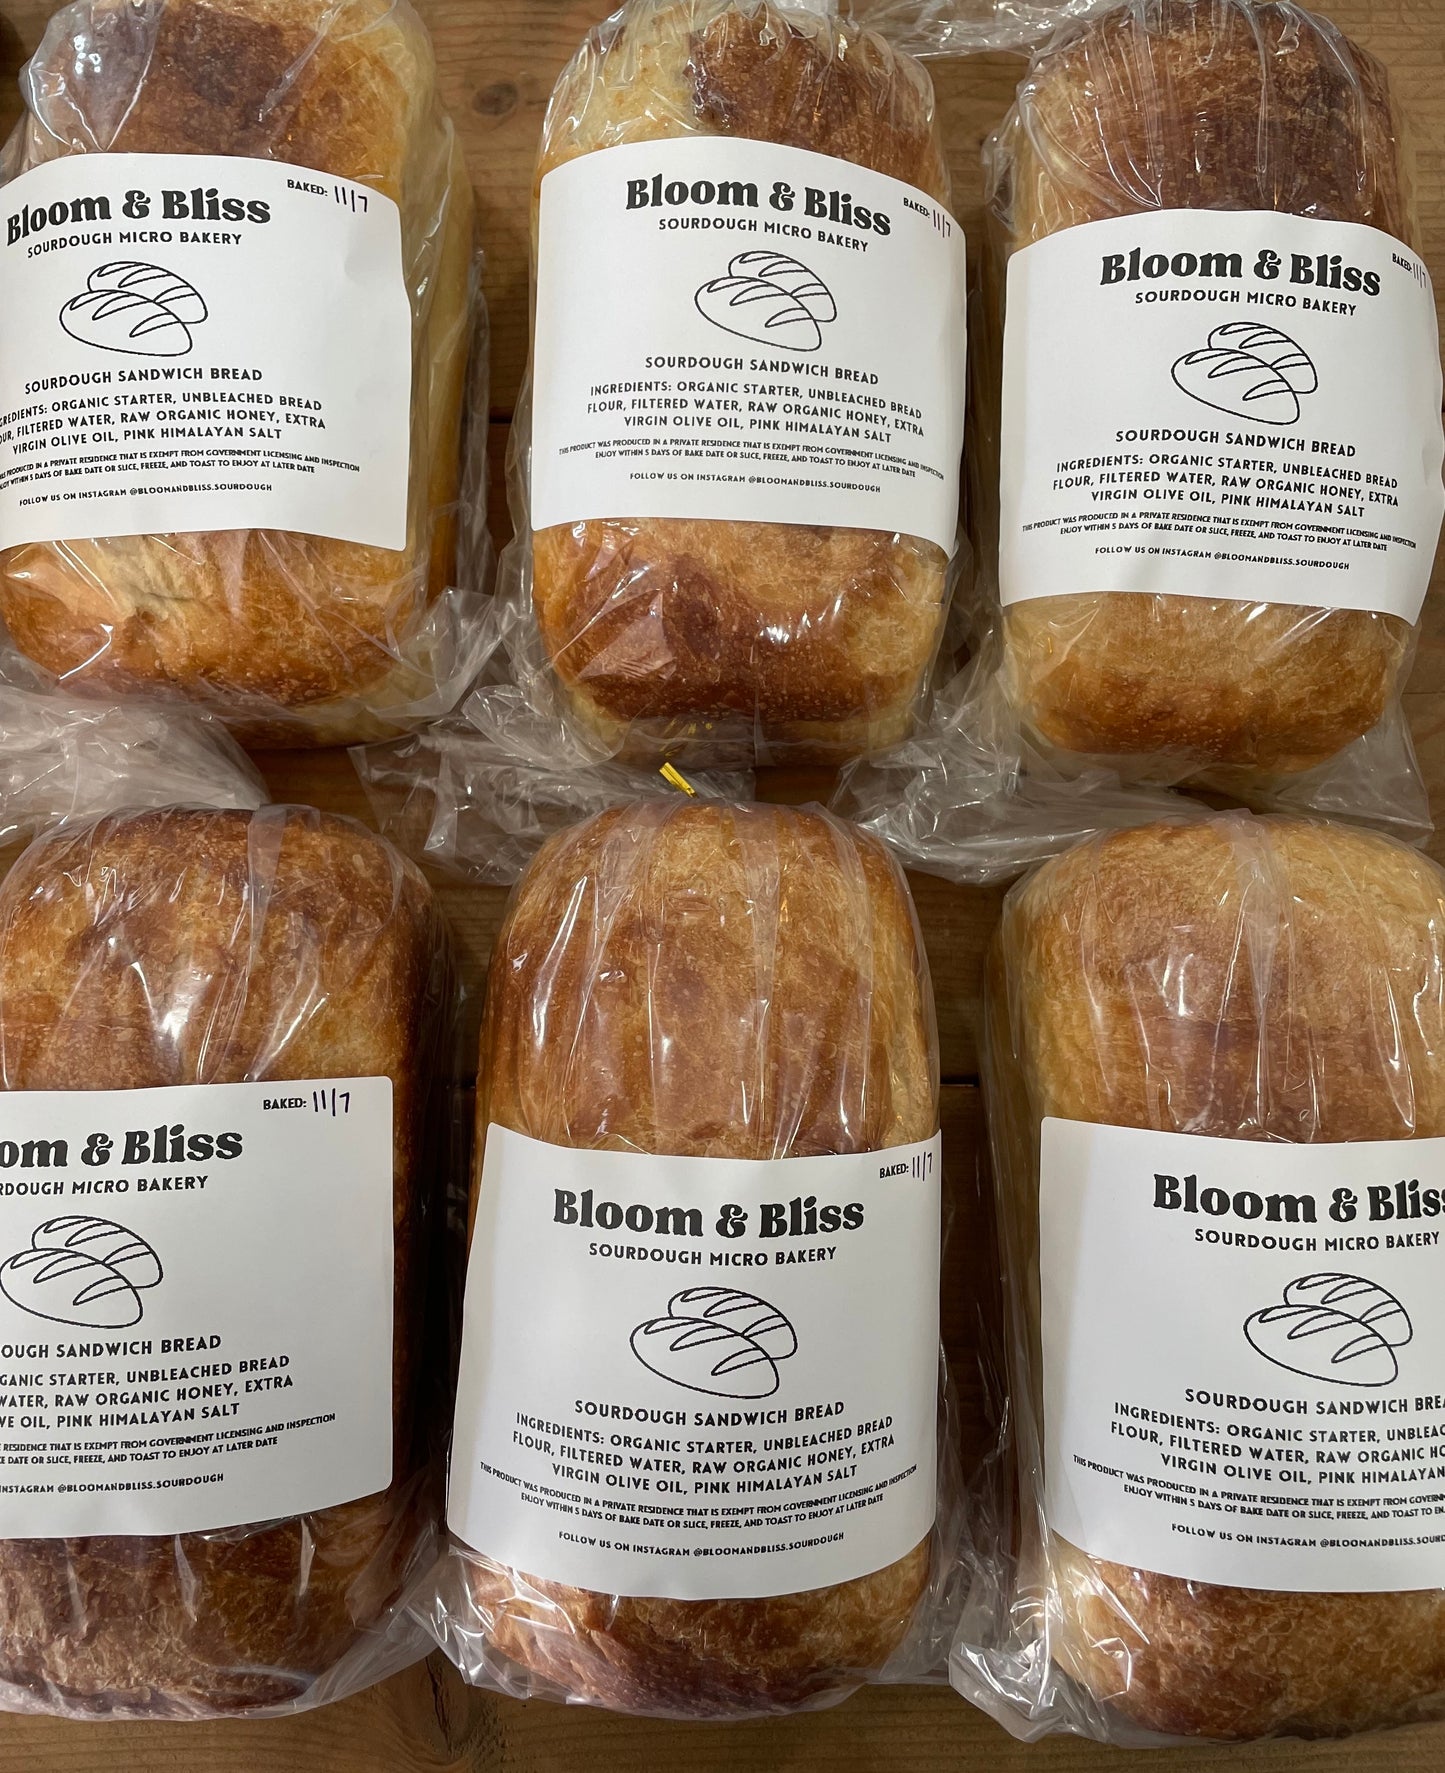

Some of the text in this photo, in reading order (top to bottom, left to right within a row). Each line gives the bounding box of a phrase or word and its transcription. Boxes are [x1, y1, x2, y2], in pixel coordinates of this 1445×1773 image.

[287, 179, 328, 196] BAKED:
[7, 187, 270, 247] Bloom & Bliss
[625, 173, 891, 236] Bloom & Bliss
[903, 198, 930, 218] BAKED:
[27, 231, 242, 258] SOURDOUGH MICRO BAKERY
[658, 217, 868, 252] SOURDOUGH MICRO BAKERY
[1099, 246, 1380, 296] Bloom & Bliss
[1135, 289, 1357, 316] SOURDOUGH MICRO BAKERY
[25, 367, 262, 395] SOURDOUGH SANDWICH BREAD
[645, 356, 878, 385] SOURDOUGH SANDWICH BREAD
[590, 381, 922, 419] INGREDIENTS: ORGANIC STARTER, UNBLEACHED BREAD
[587, 398, 924, 437] FLOUR, FILTERED WATER, RAW ORGANIC HONEY, EXTRA
[624, 415, 891, 443] VIRGIN OLIVE OIL, PINK HIMALAYAN SALT
[12, 426, 282, 455] VIRGIN OLIVE OIL, PINK HIMALAYAN SALT
[1115, 429, 1356, 457] SOURDOUGH SANDWICH BREAD
[1095, 545, 1132, 554] FOLLOW
[1134, 546, 1146, 554] US
[1162, 547, 1212, 559] INSTAGRAM
[1214, 551, 1350, 570] @BLOOMANDBLISS.SOURDOUGH
[263, 1098, 306, 1110] BAKED:
[80, 1132, 114, 1166] &
[121, 1124, 243, 1165] Bliss
[880, 1163, 909, 1178] BAKED:
[71, 1179, 129, 1195] MICRO
[137, 1175, 208, 1192] BAKERY
[1153, 1173, 1445, 1223] Bloom & Blis
[553, 1188, 864, 1239] Bloom & Bliss
[1195, 1228, 1439, 1251] SOURDOUGH MICRO BAKERY
[589, 1242, 837, 1267] SOURDOUGH MICRO BAKERY
[56, 1340, 152, 1358] SANDWICH
[161, 1334, 221, 1354] BREAD
[49, 1355, 289, 1386] STARTER, UNBLEACHED BREAD
[575, 1399, 844, 1427] SOURDOUGH SANDWICH BREAD
[1185, 1388, 1408, 1415] SOURDOUGH SANDWICH
[516, 1412, 893, 1454] INGREDIENTS: ORGANIC STARTER, UNBLEACHED BREAD
[513, 1430, 894, 1475] FLOUR, FILTERED WATER, RAW ORGANIC HONEY, EXTRA
[57, 1473, 224, 1493] @BLOOMANDBLISS.SOURDOUGH
[480, 1461, 492, 1474] THIS
[492, 1467, 522, 1487] PRODUCT
[523, 1480, 538, 1492] WAS
[539, 1486, 581, 1503] PRODUCED
[583, 1496, 592, 1505] IN
[594, 1499, 600, 1507] A
[602, 1499, 636, 1512] PRIVATE
[637, 1504, 684, 1516] RESIDENCE
[686, 1508, 709, 1516] THAT
[710, 1508, 719, 1516] IS
[721, 1506, 755, 1516] EXEMPT
[756, 1504, 781, 1514] FROM
[783, 1494, 837, 1511] GOVERNMENT
[838, 1485, 873, 1501] LICENSING
[874, 1480, 888, 1491] AND
[552, 1463, 857, 1495] VIRGIN OLIVE OIL, PINK HIMALAYAN SALT
[521, 1492, 544, 1506] ENJOY
[545, 1499, 573, 1514] WITHIN
[581, 1508, 603, 1520] DAYS
[604, 1512, 617, 1522] OF
[618, 1514, 640, 1525] BAKE
[642, 1517, 665, 1528] DATE
[666, 1519, 681, 1528] OR
[682, 1520, 708, 1530] SLICE,
[710, 1519, 742, 1529] FREEZE,
[743, 1518, 763, 1527] AND
[764, 1515, 793, 1526] TOAST
[794, 1513, 807, 1522] TO
[808, 1507, 834, 1520] ENJOY
[835, 1504, 845, 1514] AT
[846, 1499, 867, 1512] LATER
[867, 1493, 883, 1505] DATE
[559, 1531, 844, 1557] FOLLOW US ON INSTAGRAM @BLOOMANDBLISS.SOURDOUGH
